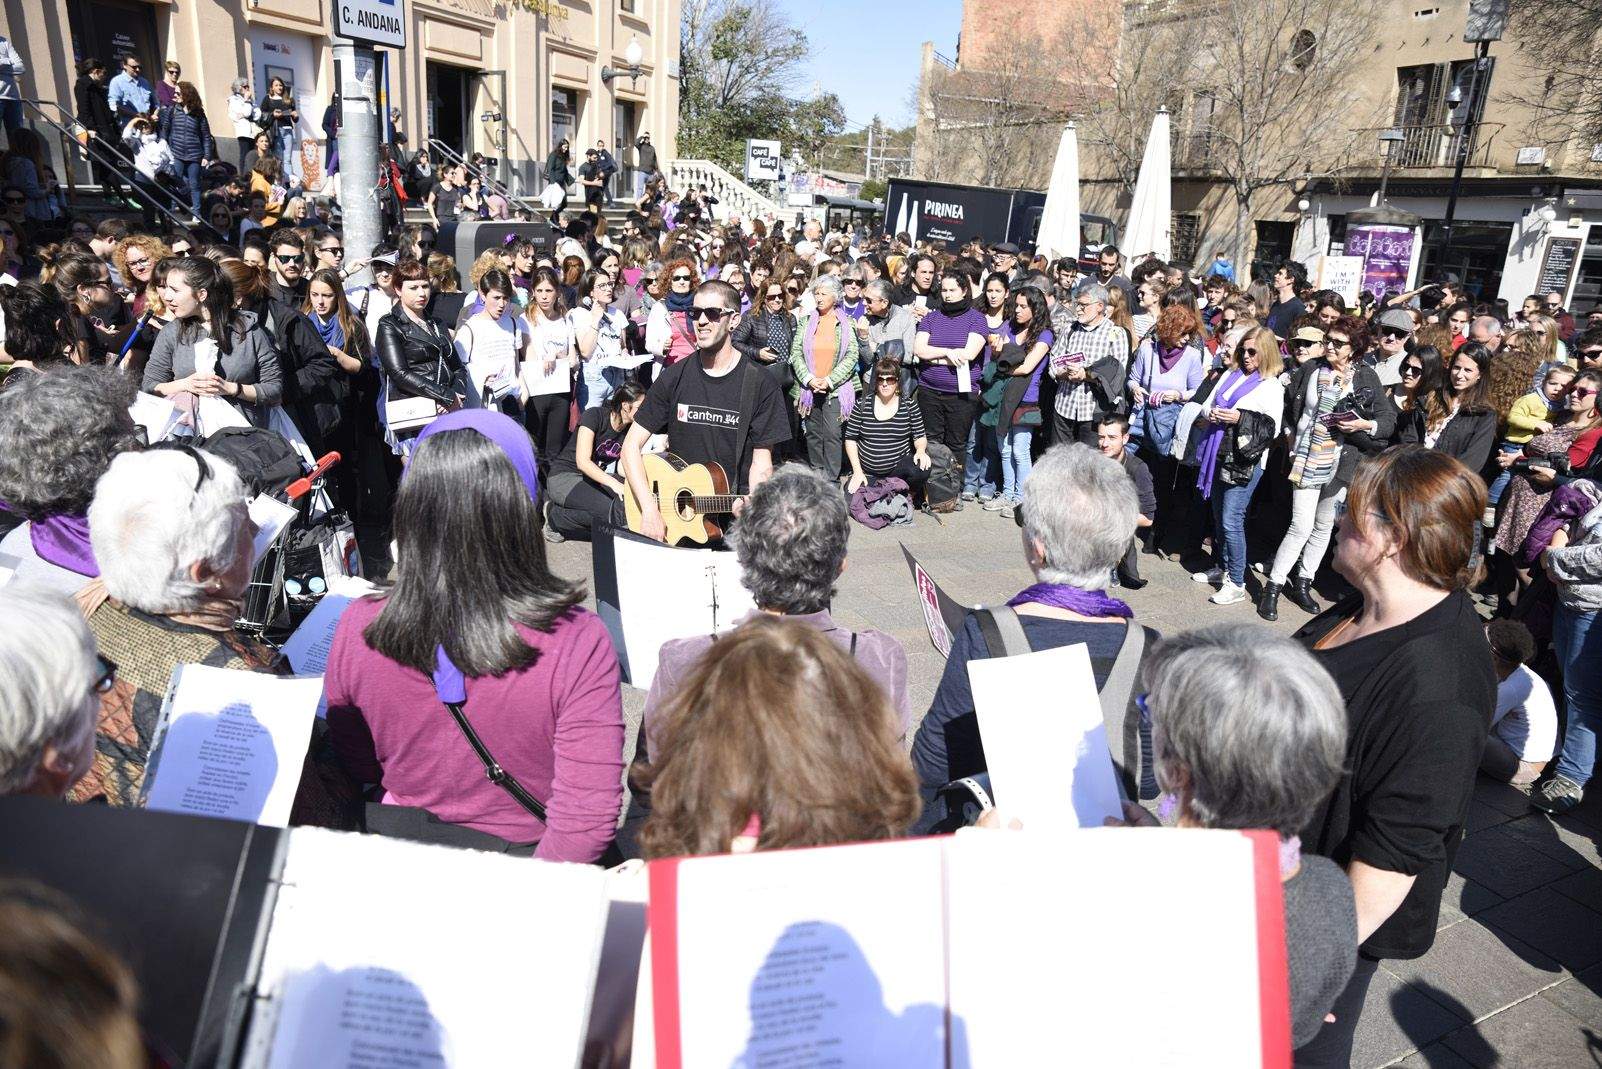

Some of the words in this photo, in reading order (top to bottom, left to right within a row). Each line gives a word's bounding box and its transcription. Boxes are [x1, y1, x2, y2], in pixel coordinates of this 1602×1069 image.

[342, 5, 354, 25] C.
[357, 9, 402, 35] ANDANA
[924, 199, 964, 220] PIRINEA
